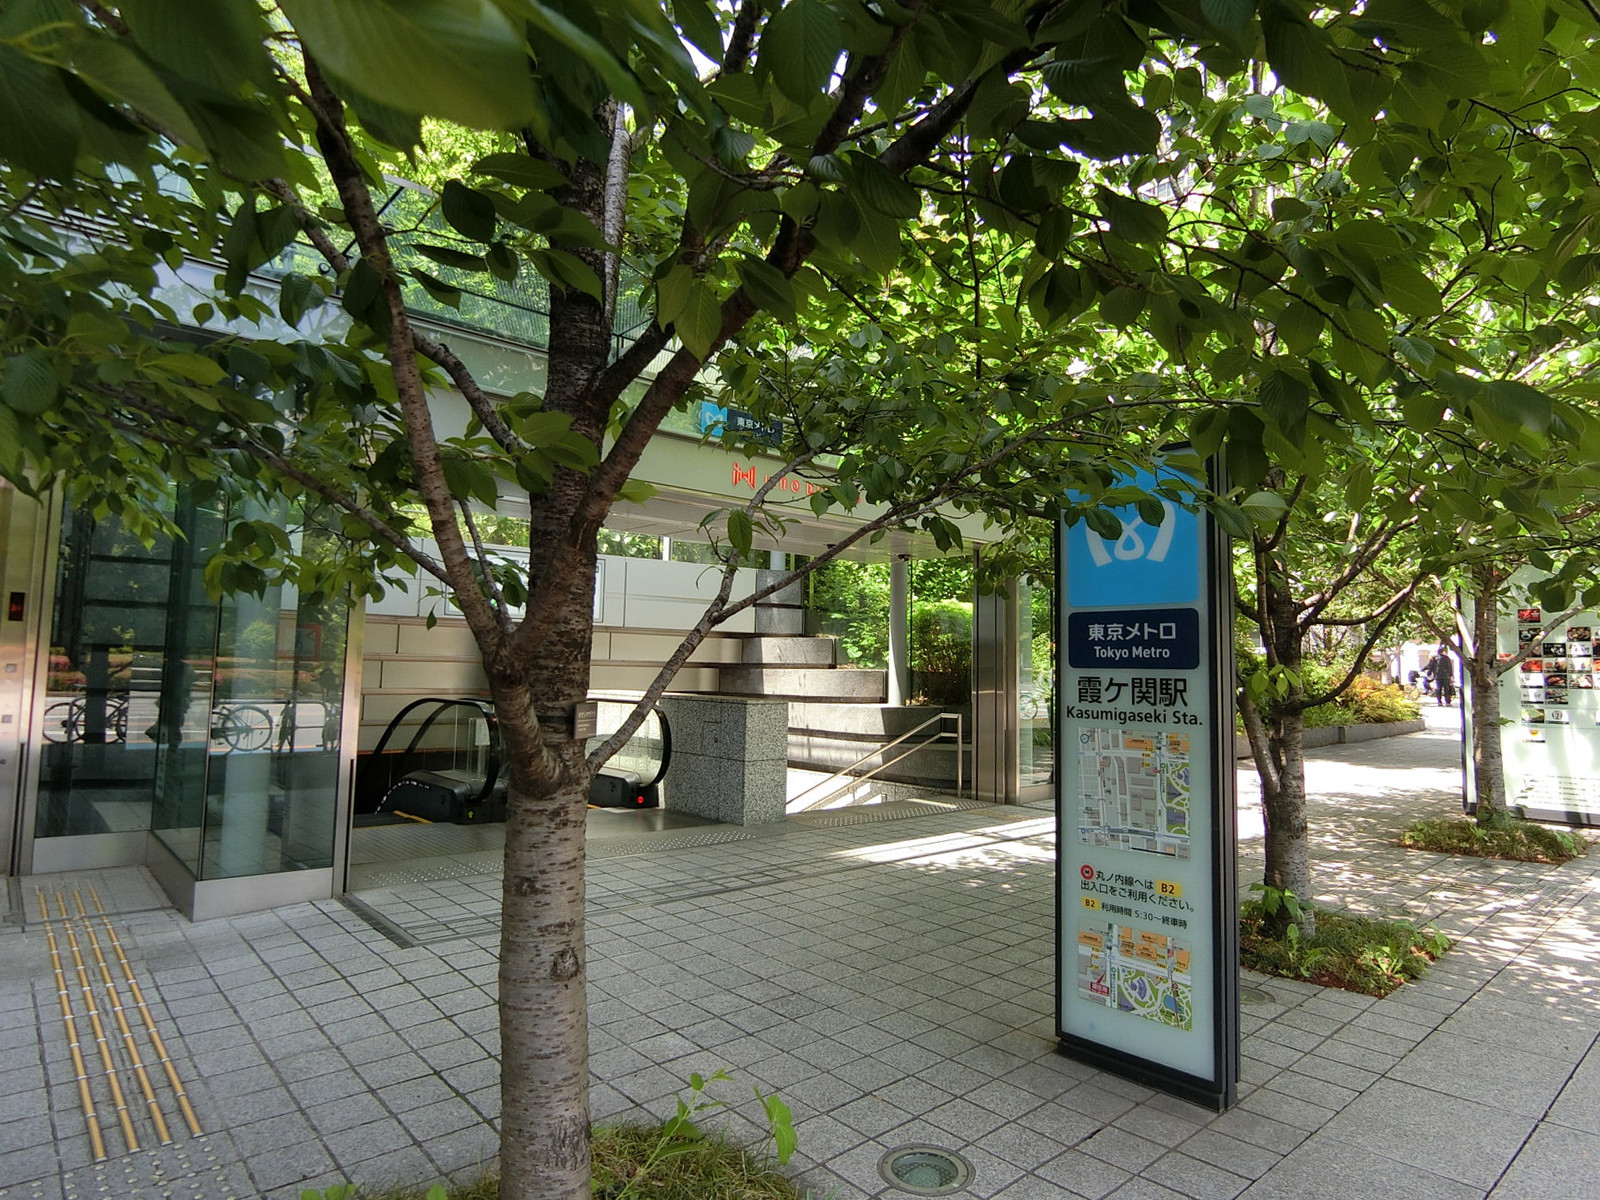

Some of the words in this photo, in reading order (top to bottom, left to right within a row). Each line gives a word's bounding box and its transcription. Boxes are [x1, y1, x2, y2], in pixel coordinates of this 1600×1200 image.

[1088, 622, 1176, 641] 東京メトロ
[1094, 646, 1129, 661] Tokyo
[1132, 646, 1170, 658] Metro
[1066, 706, 1167, 725] Kasumigaseki
[1172, 710, 1203, 726] Sta.
[1096, 870, 1154, 890] 丸ノ内線へは
[1161, 883, 1175, 895] B2
[1080, 881, 1195, 912] 出入口をご利用ください。
[1085, 898, 1096, 908] B2
